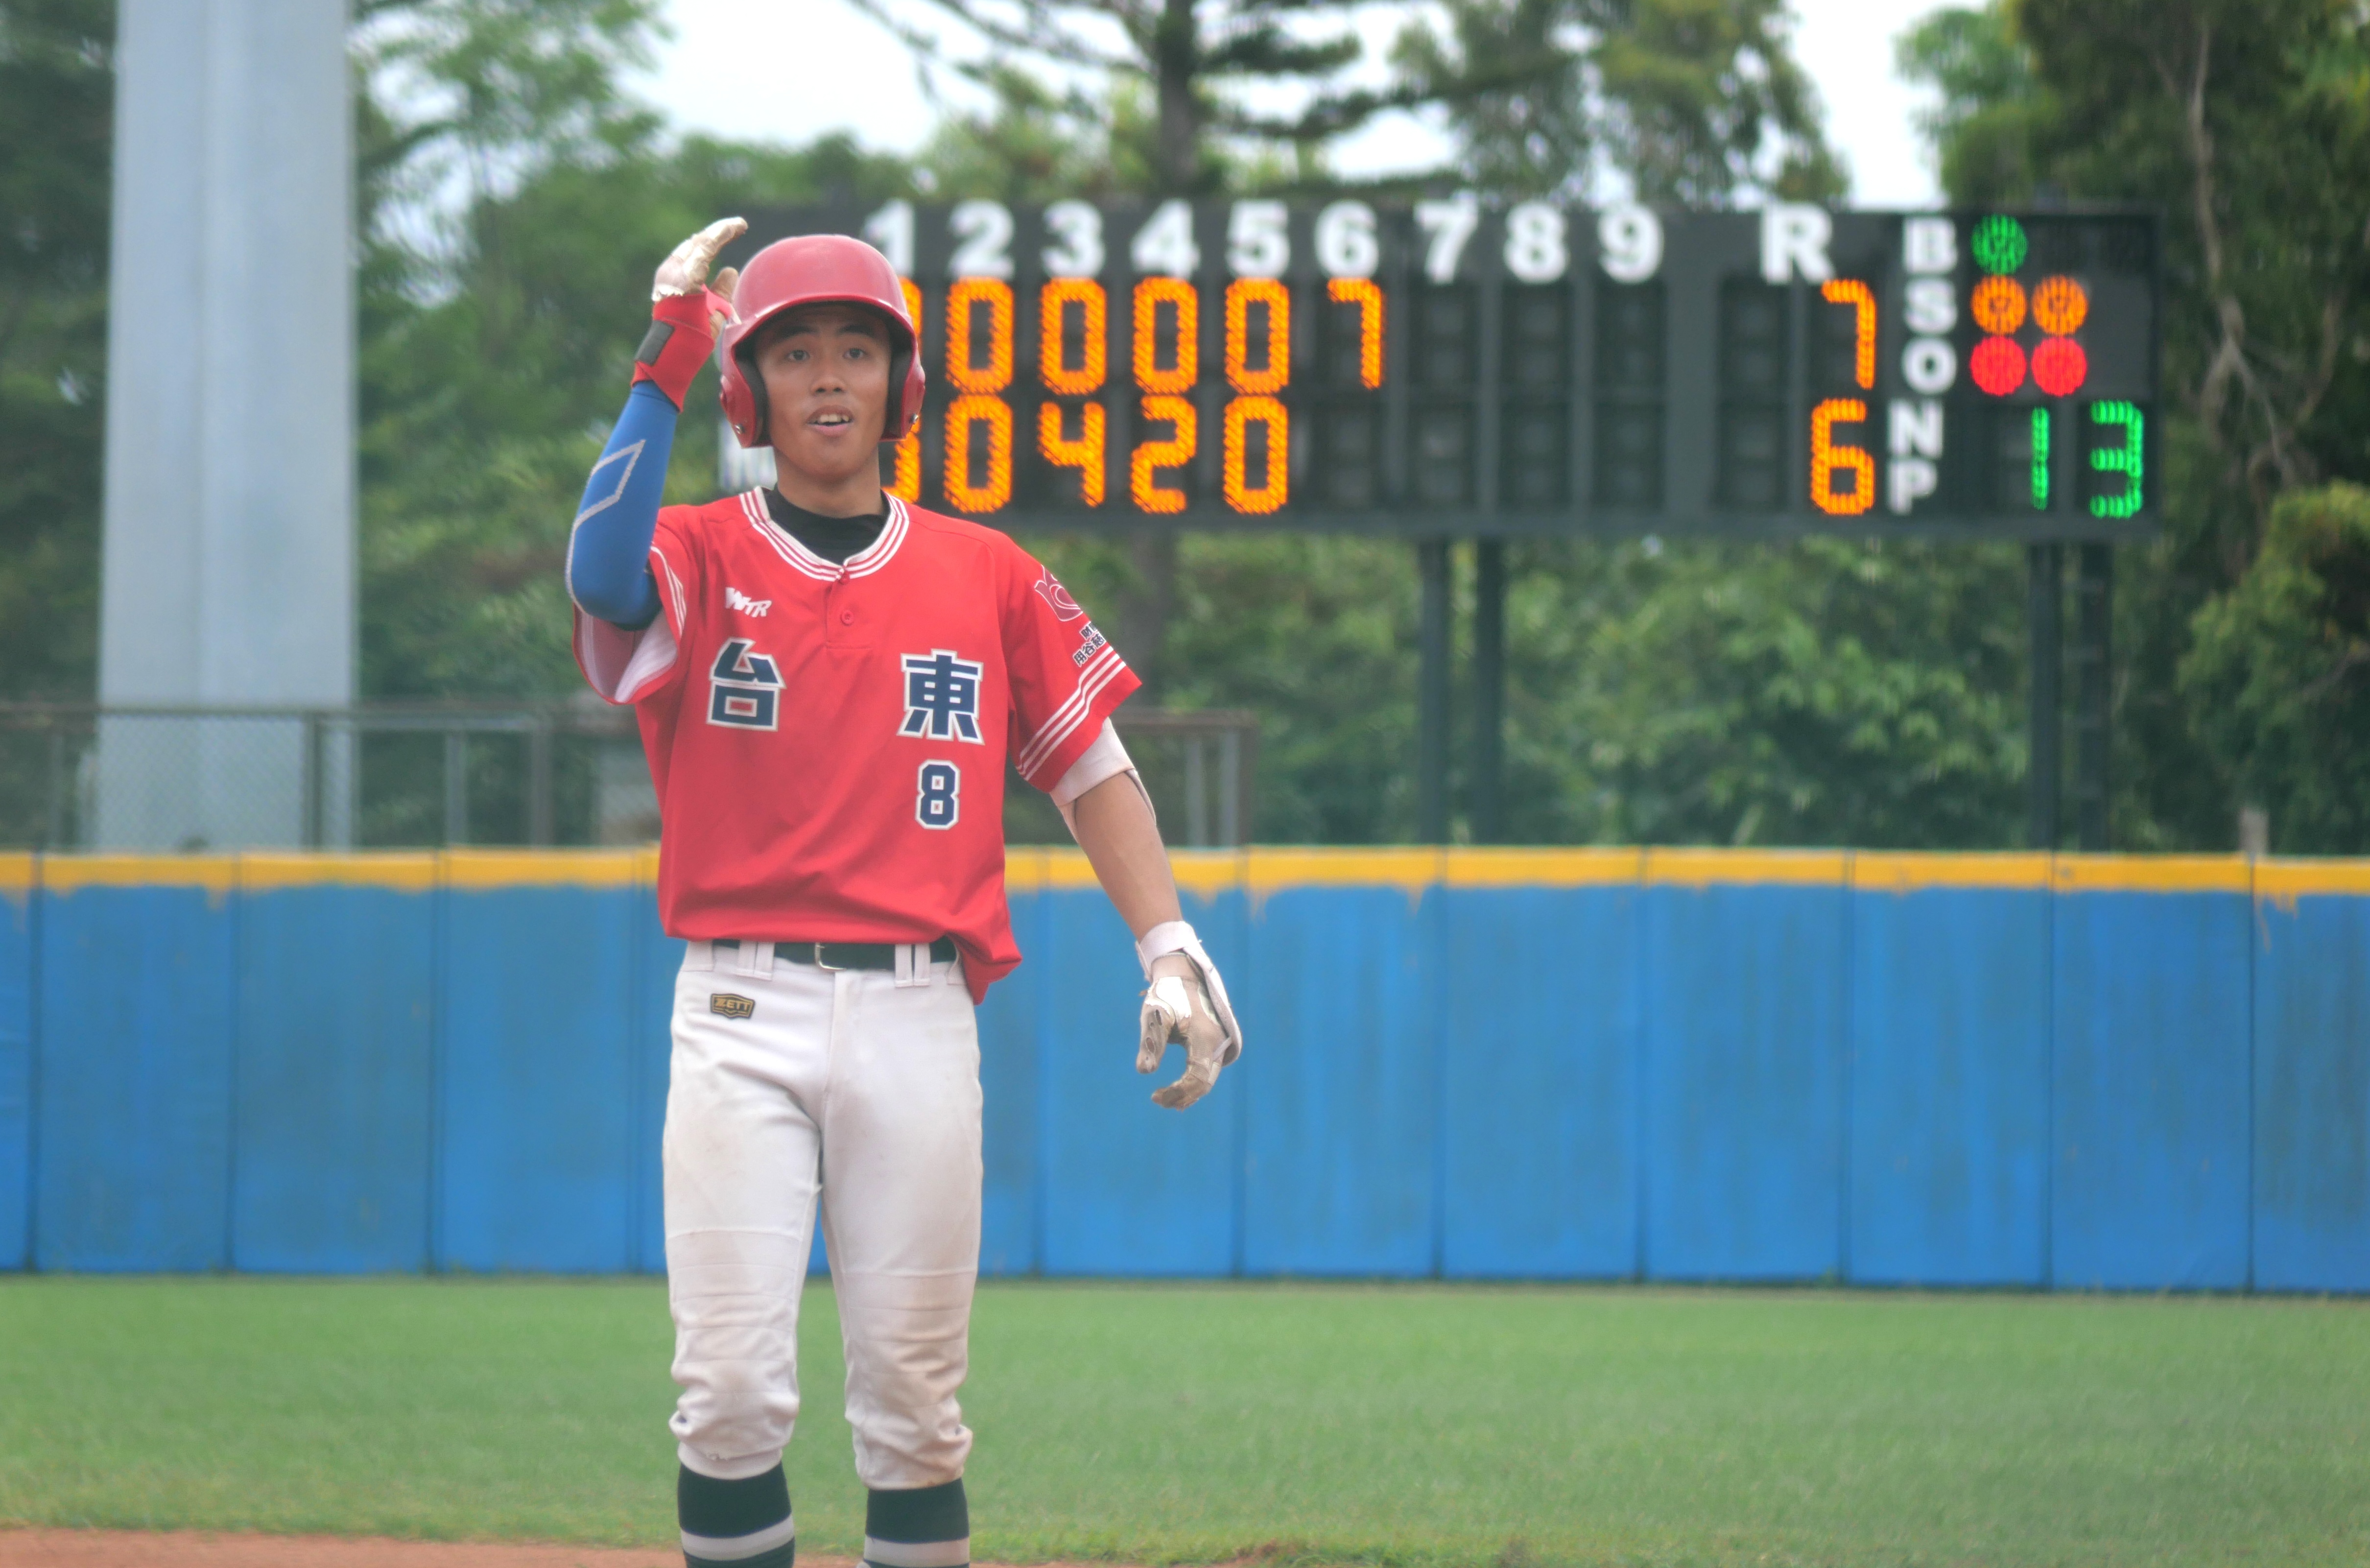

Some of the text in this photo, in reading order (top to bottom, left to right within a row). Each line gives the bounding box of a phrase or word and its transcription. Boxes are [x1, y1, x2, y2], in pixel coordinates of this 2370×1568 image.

[865, 200, 1833, 283] 1 2 3 4 5 6 7 8 9 R
[1903, 217, 1957, 274] B
[946, 277, 1014, 393] 0
[1040, 277, 1106, 394] 0
[1133, 277, 1198, 393] 0
[1225, 277, 1289, 393] 0
[1327, 277, 1383, 388] 7
[1821, 279, 1876, 389] 7
[1904, 278, 1957, 335] S
[944, 394, 1012, 513] 0
[1039, 402, 1105, 507] 4
[1131, 395, 1197, 514] 2
[1224, 395, 1288, 514] 0
[1811, 399, 1875, 515] 6
[915, 760, 960, 830] 8
[714, 998, 751, 1011] ZETT
